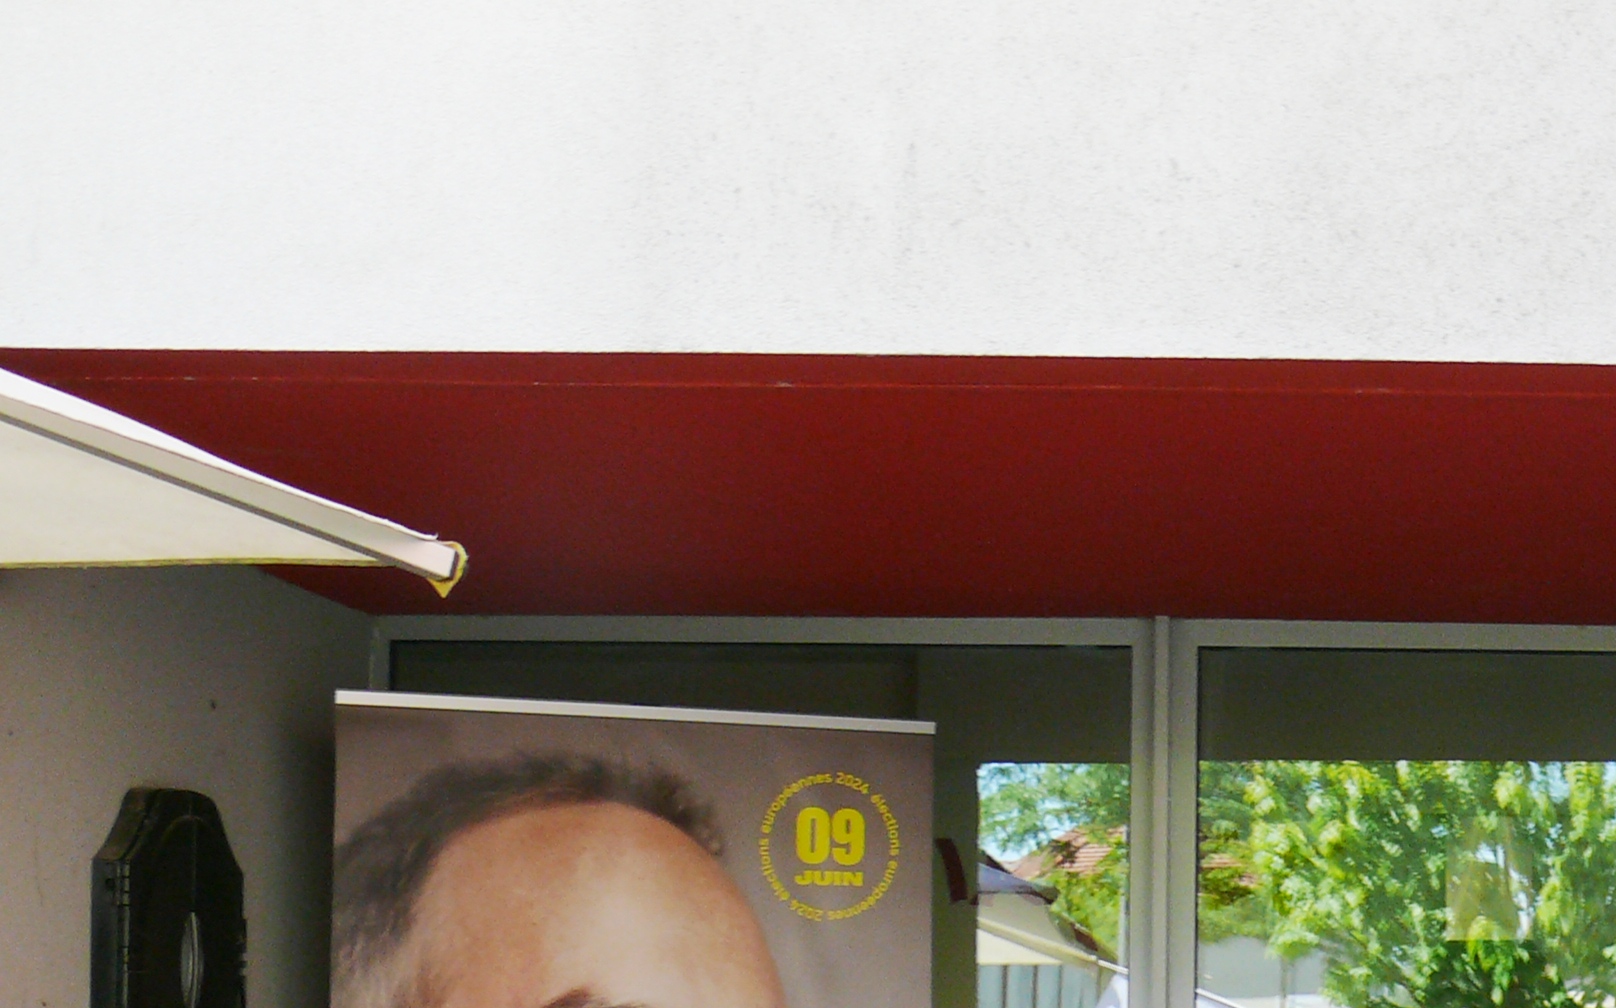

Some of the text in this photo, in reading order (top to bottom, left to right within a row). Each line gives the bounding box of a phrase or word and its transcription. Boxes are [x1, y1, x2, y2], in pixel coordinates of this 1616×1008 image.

[834, 771, 871, 795] 2024
[796, 806, 866, 866] 09
[794, 869, 864, 887] JUIN
